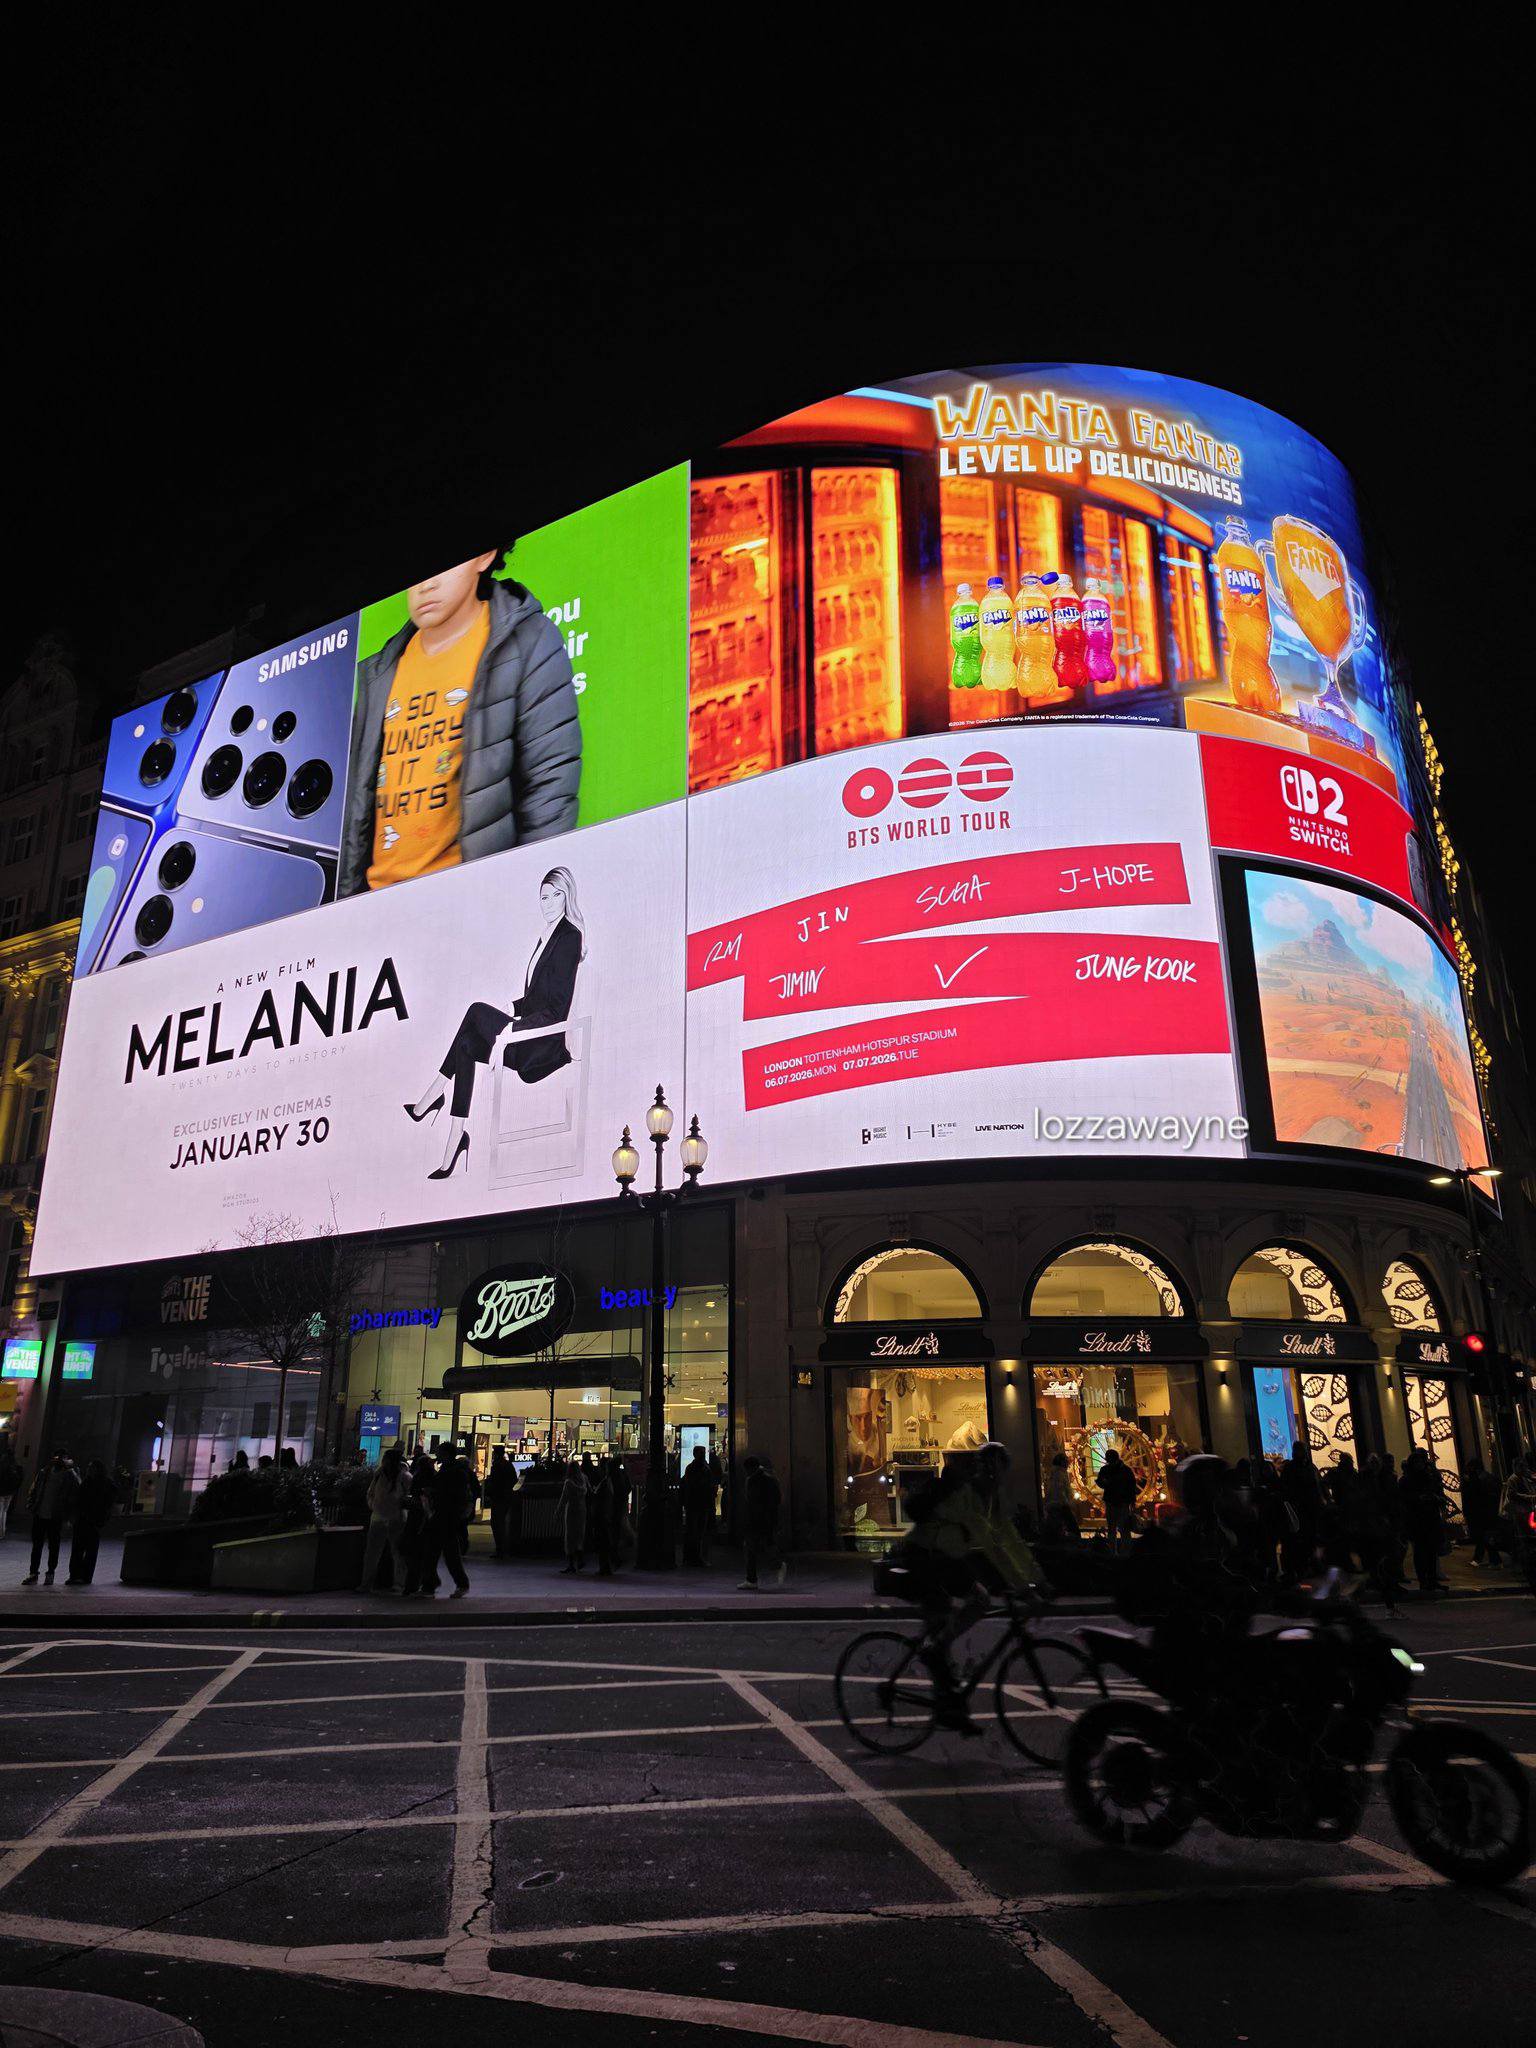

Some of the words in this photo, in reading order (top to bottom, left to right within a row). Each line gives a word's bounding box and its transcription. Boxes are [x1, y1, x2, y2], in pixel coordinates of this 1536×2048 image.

[933, 384, 1119, 446] WANTA
[1131, 409, 1243, 477] FANTA?
[940, 445, 1037, 476] LEVEL
[1045, 446, 1082, 473] UP
[1090, 449, 1243, 506] DELICIOUSNESS
[1286, 541, 1342, 584] FANTA
[1224, 568, 1262, 590] FANTA
[542, 597, 581, 627] ou
[982, 608, 1012, 625] FANTA
[258, 628, 349, 683] SAMSUNG
[407, 691, 436, 720] SO
[384, 716, 464, 756] UNGRY
[398, 757, 421, 786] IT
[847, 826, 880, 849] BTS
[886, 816, 951, 842] WORLD
[960, 810, 1011, 833] TOUR
[1288, 816, 1349, 840] NINTENDO
[1289, 826, 1351, 856] SWITCH
[1058, 863, 1154, 893] J-HOPE
[915, 874, 991, 914] SUGA
[797, 906, 849, 943] JIN
[217, 982, 224, 993] A
[234, 970, 268, 989] NEW
[278, 957, 316, 978] FILM
[769, 965, 826, 999] JIMIN
[1075, 954, 1141, 981] JUNG
[1143, 956, 1197, 983] KOOK
[124, 957, 410, 1085] MELANIA
[764, 1057, 803, 1075] LONDON
[804, 1043, 861, 1065] TOTTENHAM
[862, 1034, 911, 1053] HOTSPUR
[911, 1027, 957, 1044] STADIUM
[171, 1074, 218, 1091] TWENTY
[226, 1065, 257, 1080] DAYS
[266, 1060, 281, 1071] TO
[289, 1045, 348, 1066] HISTORY
[173, 1111, 252, 1138] EXCLUSIVELY
[256, 1107, 269, 1122] IN
[273, 1095, 332, 1118] CINEMAS
[993, 1123, 1024, 1132] NATION
[169, 1123, 290, 1170] JANUARY
[296, 1116, 330, 1147] 30
[184, 1275, 212, 1299] THE
[601, 1286, 677, 1311] beauy
[161, 1297, 209, 1323] VENUE
[348, 1306, 443, 1338] pharmacy
[466, 1275, 558, 1341] Boots
[870, 1335, 926, 1356] Lindt
[1079, 1332, 1137, 1353] Lindt
[1280, 1334, 1322, 1355] Lindt
[514, 1454, 532, 1462] DIOR
